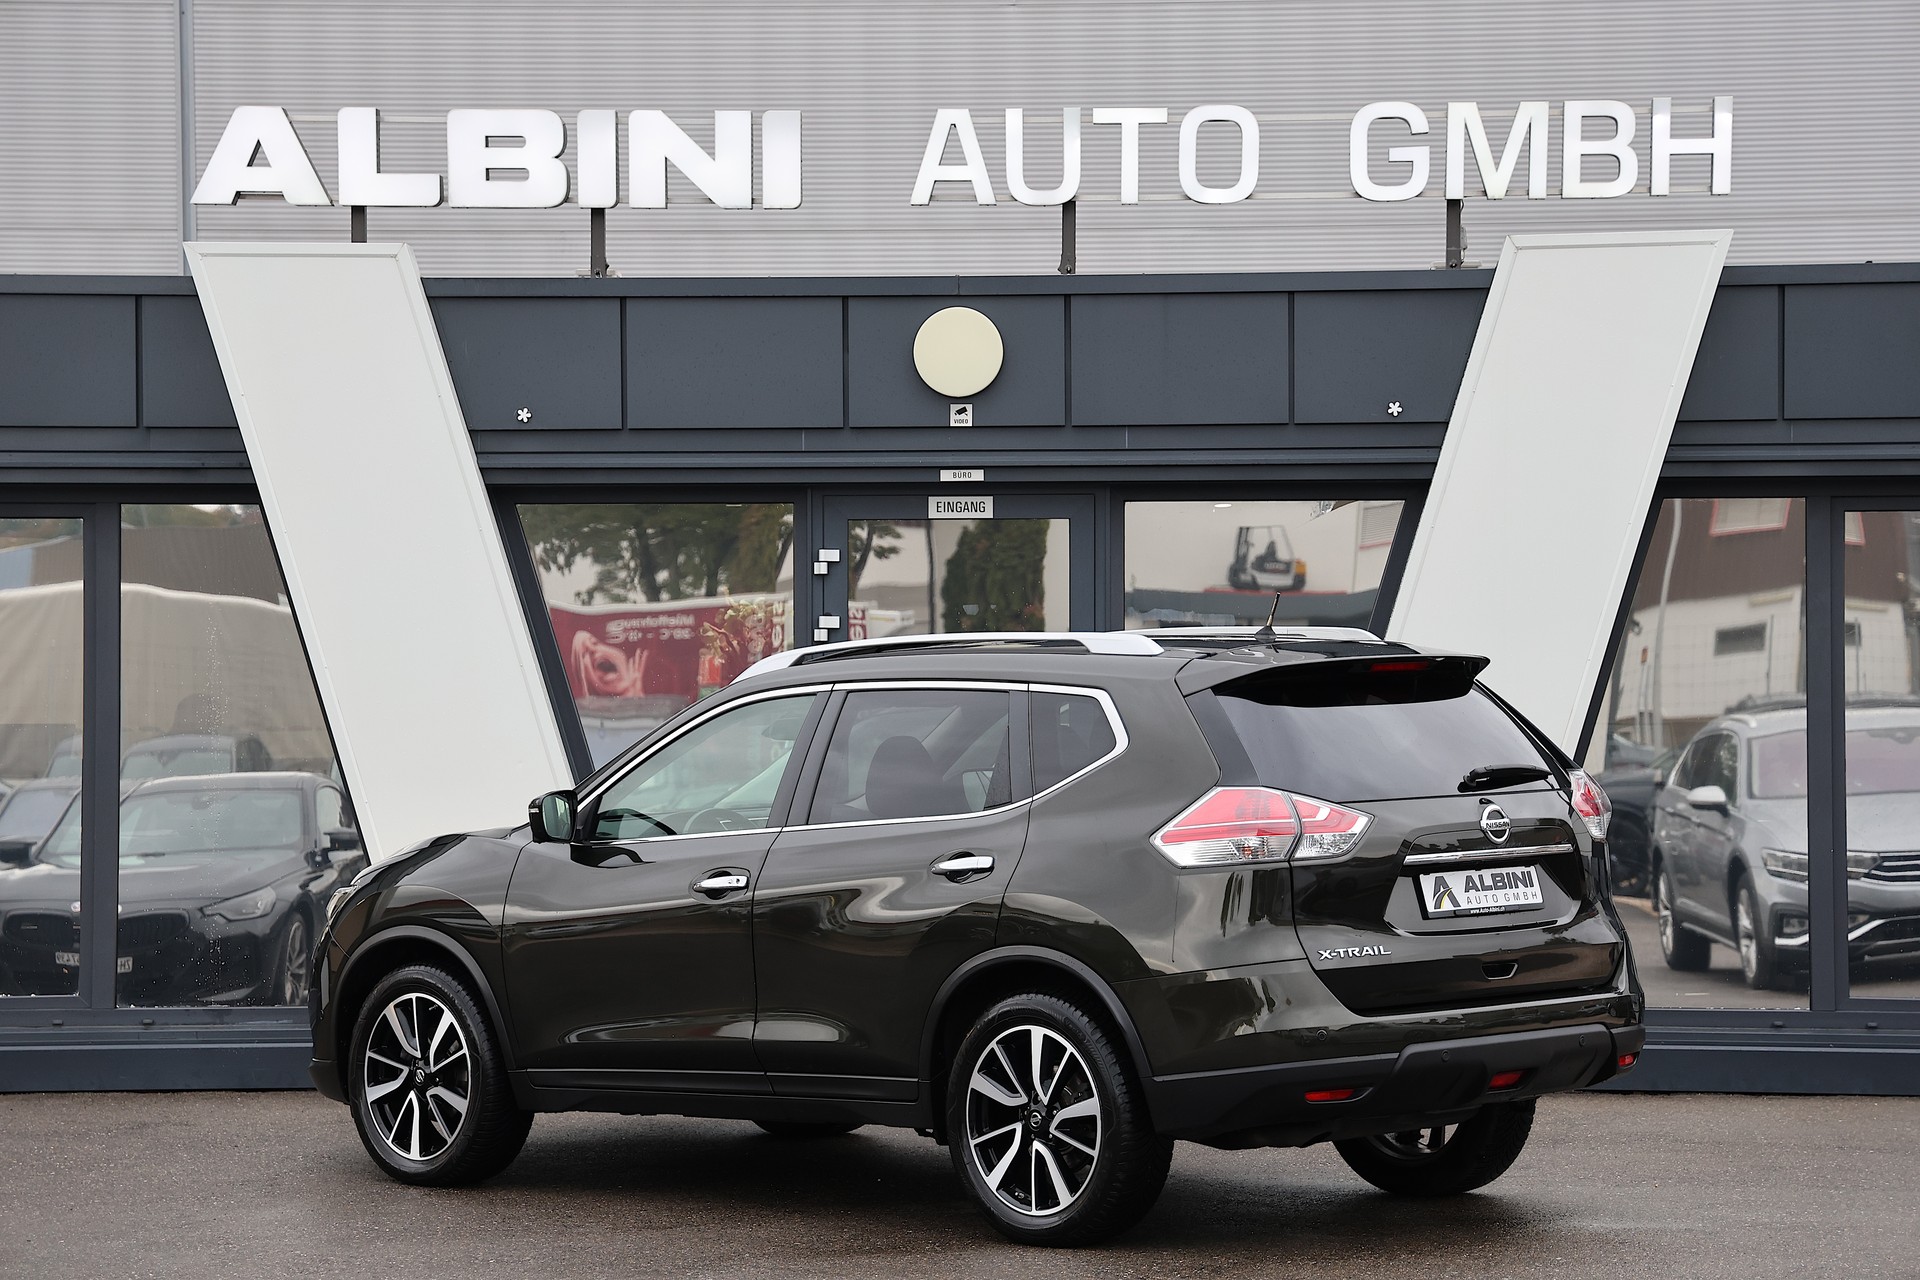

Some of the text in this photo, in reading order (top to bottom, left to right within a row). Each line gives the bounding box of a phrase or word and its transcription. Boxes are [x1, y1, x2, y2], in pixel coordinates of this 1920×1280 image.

[190, 96, 1734, 210] ALBINI AUTO GMBH
[952, 470, 972, 479] BÜRO
[936, 501, 986, 513] EINGANG
[1485, 821, 1510, 830] NISSAN
[1464, 870, 1535, 893] ALBINI
[1466, 891, 1538, 906] AUTO GMBH
[1317, 945, 1392, 960] X-TRAIL
